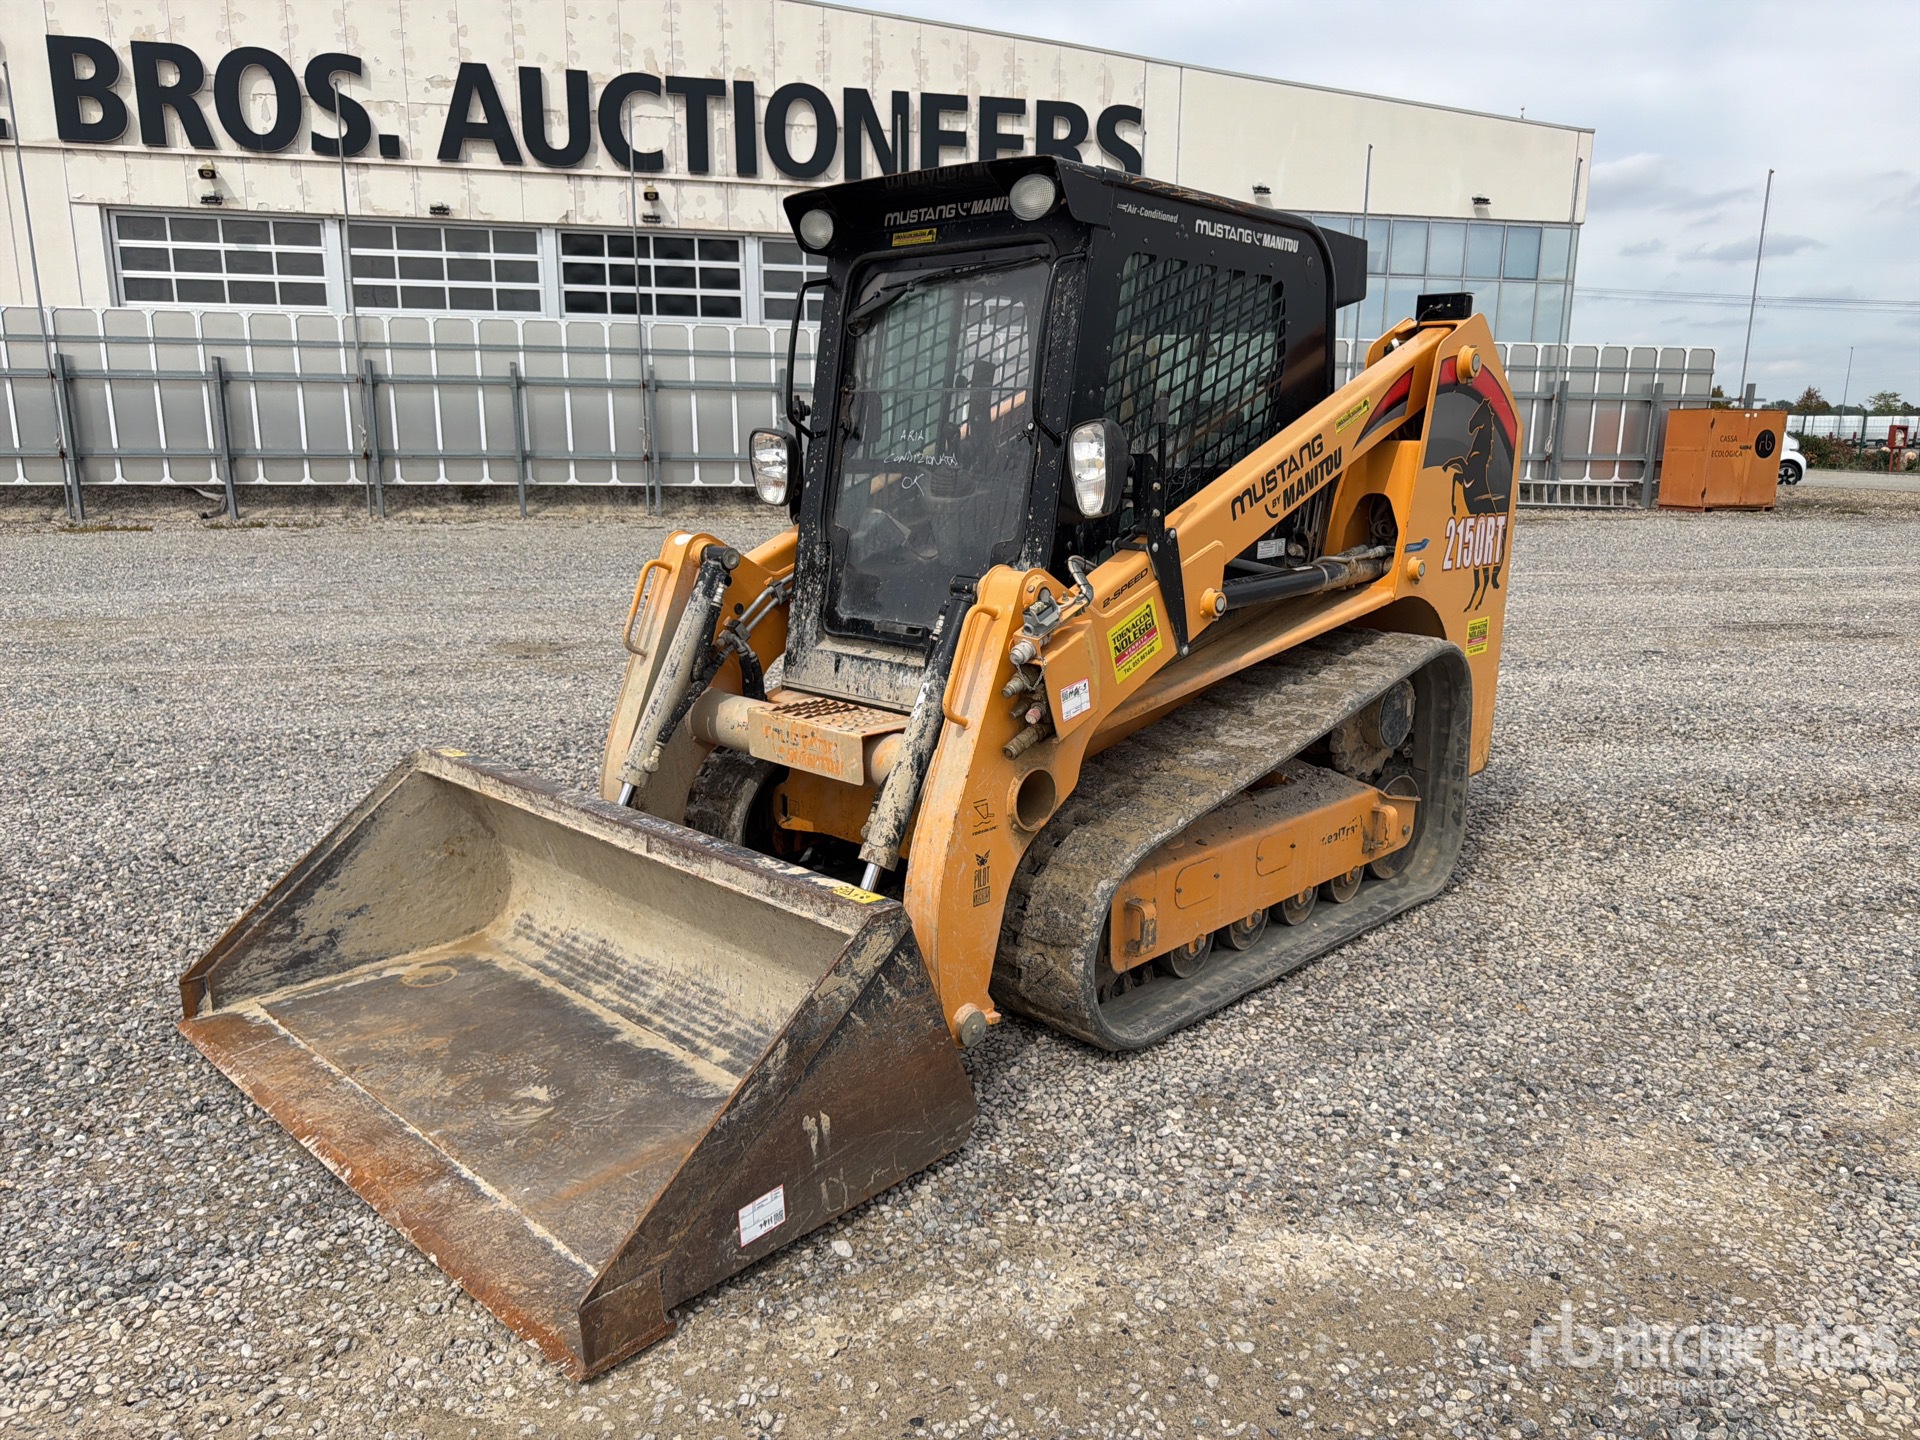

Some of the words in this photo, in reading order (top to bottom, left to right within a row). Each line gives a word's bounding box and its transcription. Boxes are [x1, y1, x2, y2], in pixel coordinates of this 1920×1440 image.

[45, 34, 400, 158] BROS.
[437, 62, 1143, 179] AUCTIONEERS
[884, 203, 957, 227] MUSTANG
[963, 201, 971, 209] BY
[971, 196, 1009, 215] MANIT
[1127, 203, 1179, 224] Air-Conditioned
[1195, 219, 1253, 244] MUSTANG
[1262, 233, 1299, 253] MANITOU
[900, 429, 924, 441] ARIA
[1720, 435, 1738, 443] CASSA
[1759, 434, 1773, 451] rb
[1711, 450, 1743, 458] ECOLOGICA
[901, 473, 925, 496] OK
[1231, 433, 1323, 521] MUSTANG
[1272, 494, 1281, 509] BY
[1283, 446, 1342, 511] MANITOU
[1442, 513, 1507, 571] 2150RT
[1103, 567, 1148, 608] 2-SPEED
[974, 866, 990, 889] PILOT
